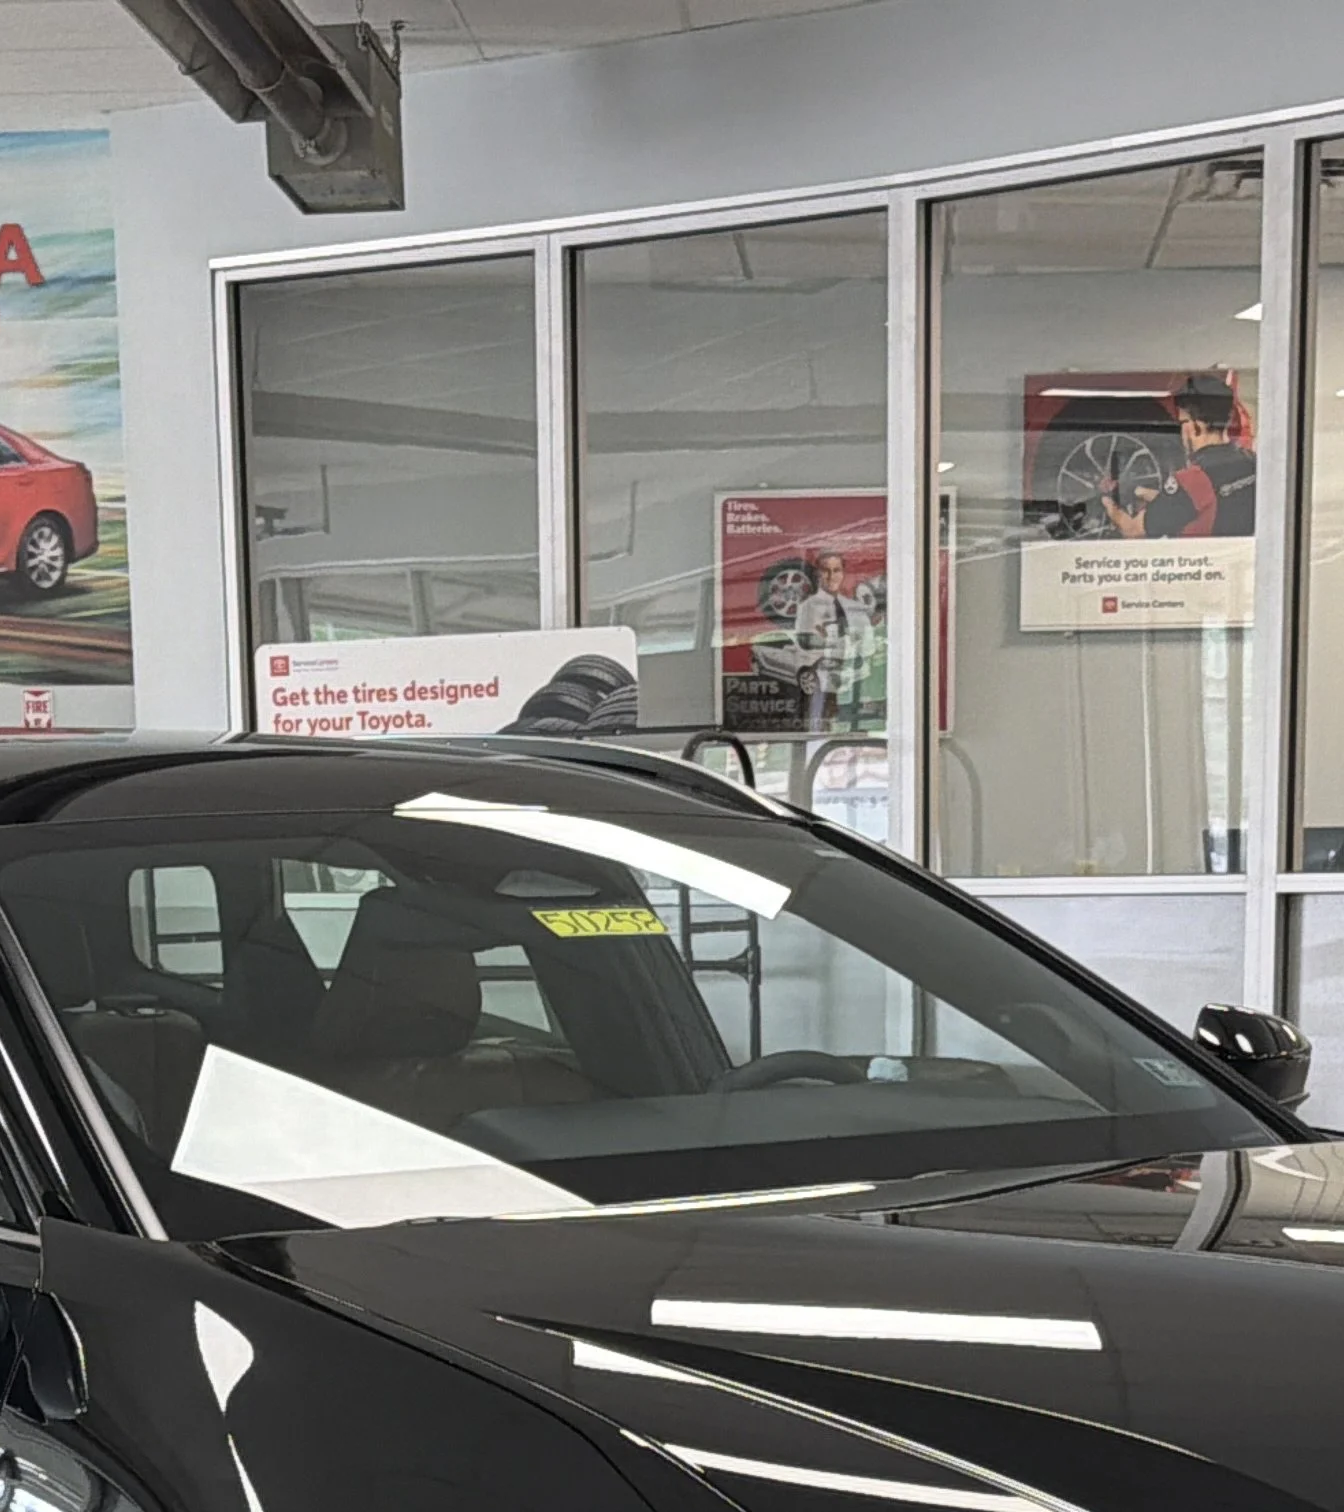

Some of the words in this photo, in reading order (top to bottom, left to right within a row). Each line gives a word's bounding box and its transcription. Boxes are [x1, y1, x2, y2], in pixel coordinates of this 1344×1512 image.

[726, 512, 770, 523] Brakes.
[726, 523, 783, 535] Batteries.
[1074, 556, 1121, 570] Service
[1123, 559, 1149, 571] you
[1151, 558, 1174, 568] can
[1177, 556, 1214, 568] trust.
[1061, 571, 1095, 584] Parts
[1097, 573, 1122, 585] you
[1124, 573, 1148, 582] can
[1151, 570, 1202, 585] depend
[1204, 572, 1226, 581] on.
[272, 686, 310, 707] Get
[313, 684, 349, 705] the
[353, 682, 398, 704] tires
[403, 676, 500, 705] designed
[726, 678, 780, 694] PARTS
[26, 700, 49, 714] FIRE
[273, 713, 304, 734] for
[306, 715, 353, 736] your
[357, 711, 433, 735] Toyota.
